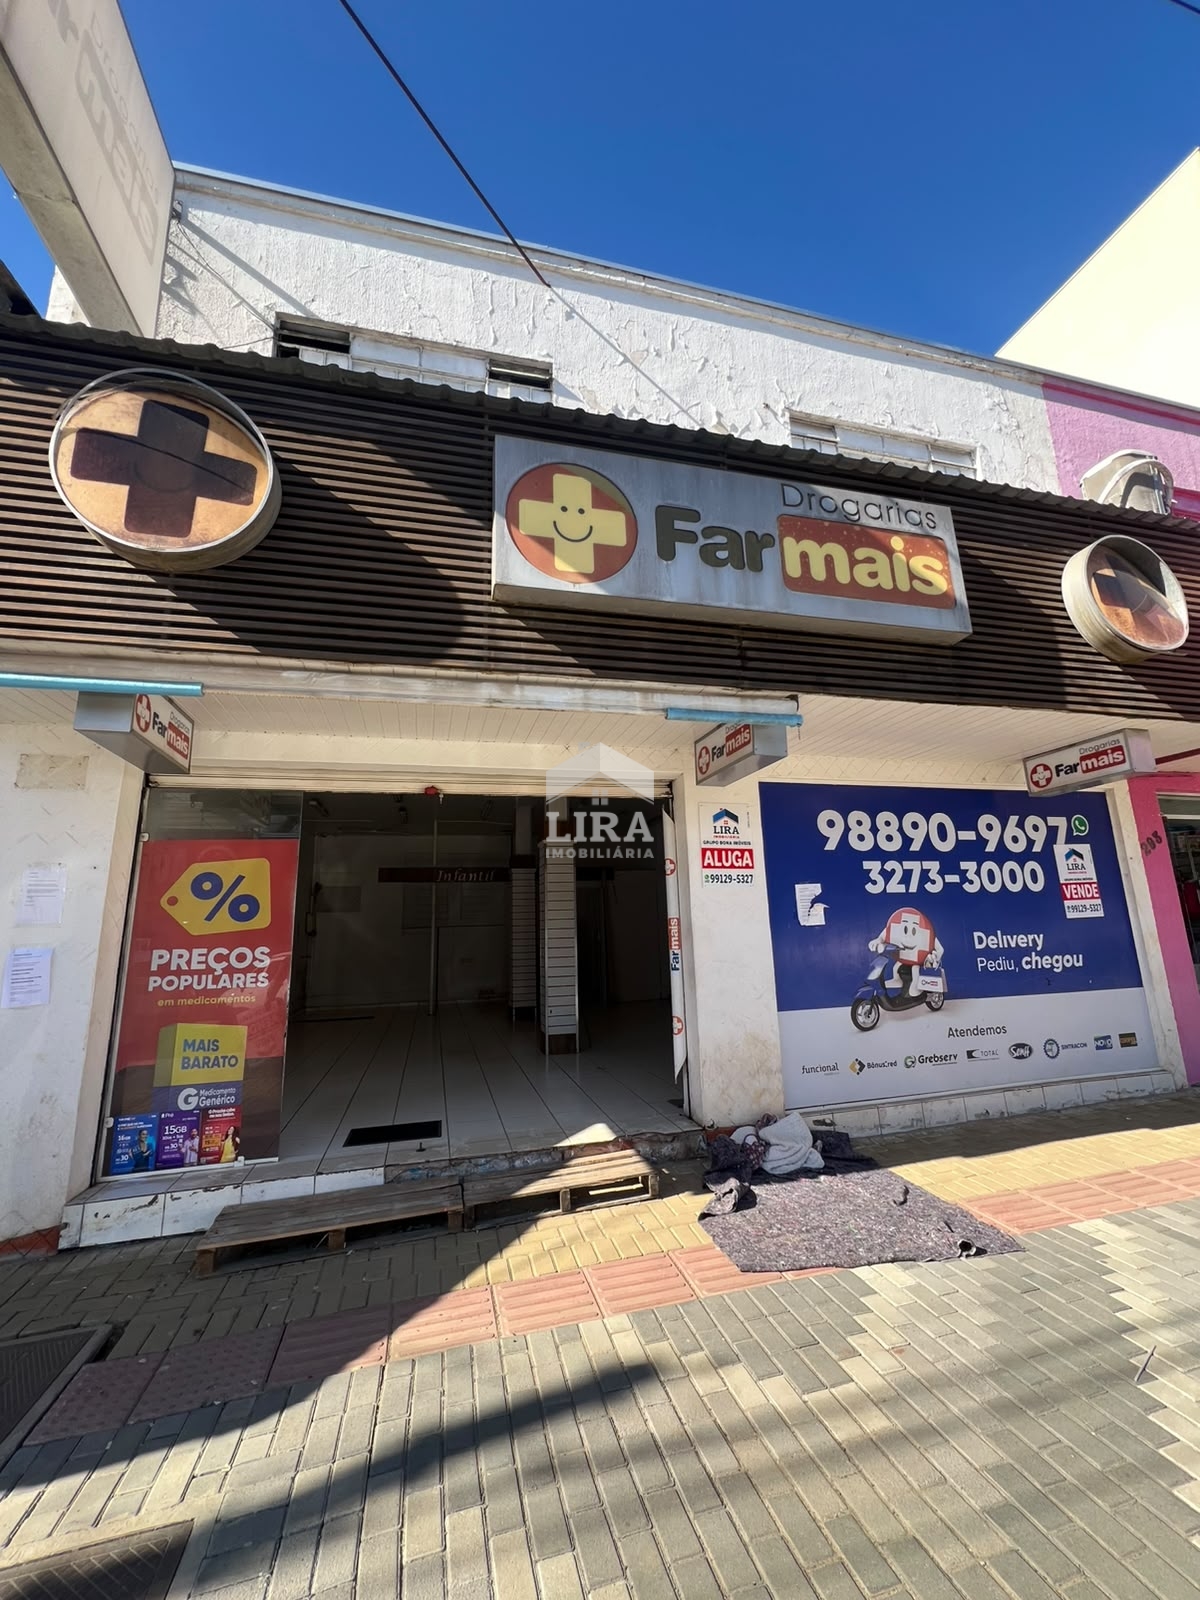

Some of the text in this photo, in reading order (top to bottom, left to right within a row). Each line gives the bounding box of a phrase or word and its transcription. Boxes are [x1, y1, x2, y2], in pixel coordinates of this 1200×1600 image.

[781, 483, 937, 530] Drogarias
[655, 504, 948, 596] Farmais
[1079, 738, 1120, 755] Drogarias
[1054, 749, 1124, 778] Farmais
[713, 825, 740, 834] LIRA
[817, 809, 1067, 852] 98890-9697
[703, 850, 753, 868] ALUGA
[436, 867, 495, 881] Infantil
[1066, 863, 1086, 871] LIRA
[710, 874, 754, 884] 99129-5327
[862, 860, 1045, 894] 3273-3000
[1062, 884, 1100, 899] VENDE
[973, 930, 1043, 951] Delivery
[150, 947, 271, 975] PREÇOS
[977, 952, 1083, 973] Pediu, chegou
[148, 972, 269, 992] POPULARES
[157, 995, 256, 1007] em medicamentos
[947, 1025, 1007, 1038] Atendemos
[183, 1039, 220, 1053] MAIS
[181, 1055, 239, 1071] BARATO
[917, 1053, 958, 1064] Grebserv
[801, 1062, 840, 1074] funcional
[200, 1088, 236, 1097] Medicamento
[199, 1094, 236, 1107] Genérico
[164, 1125, 187, 1135] 15GB
